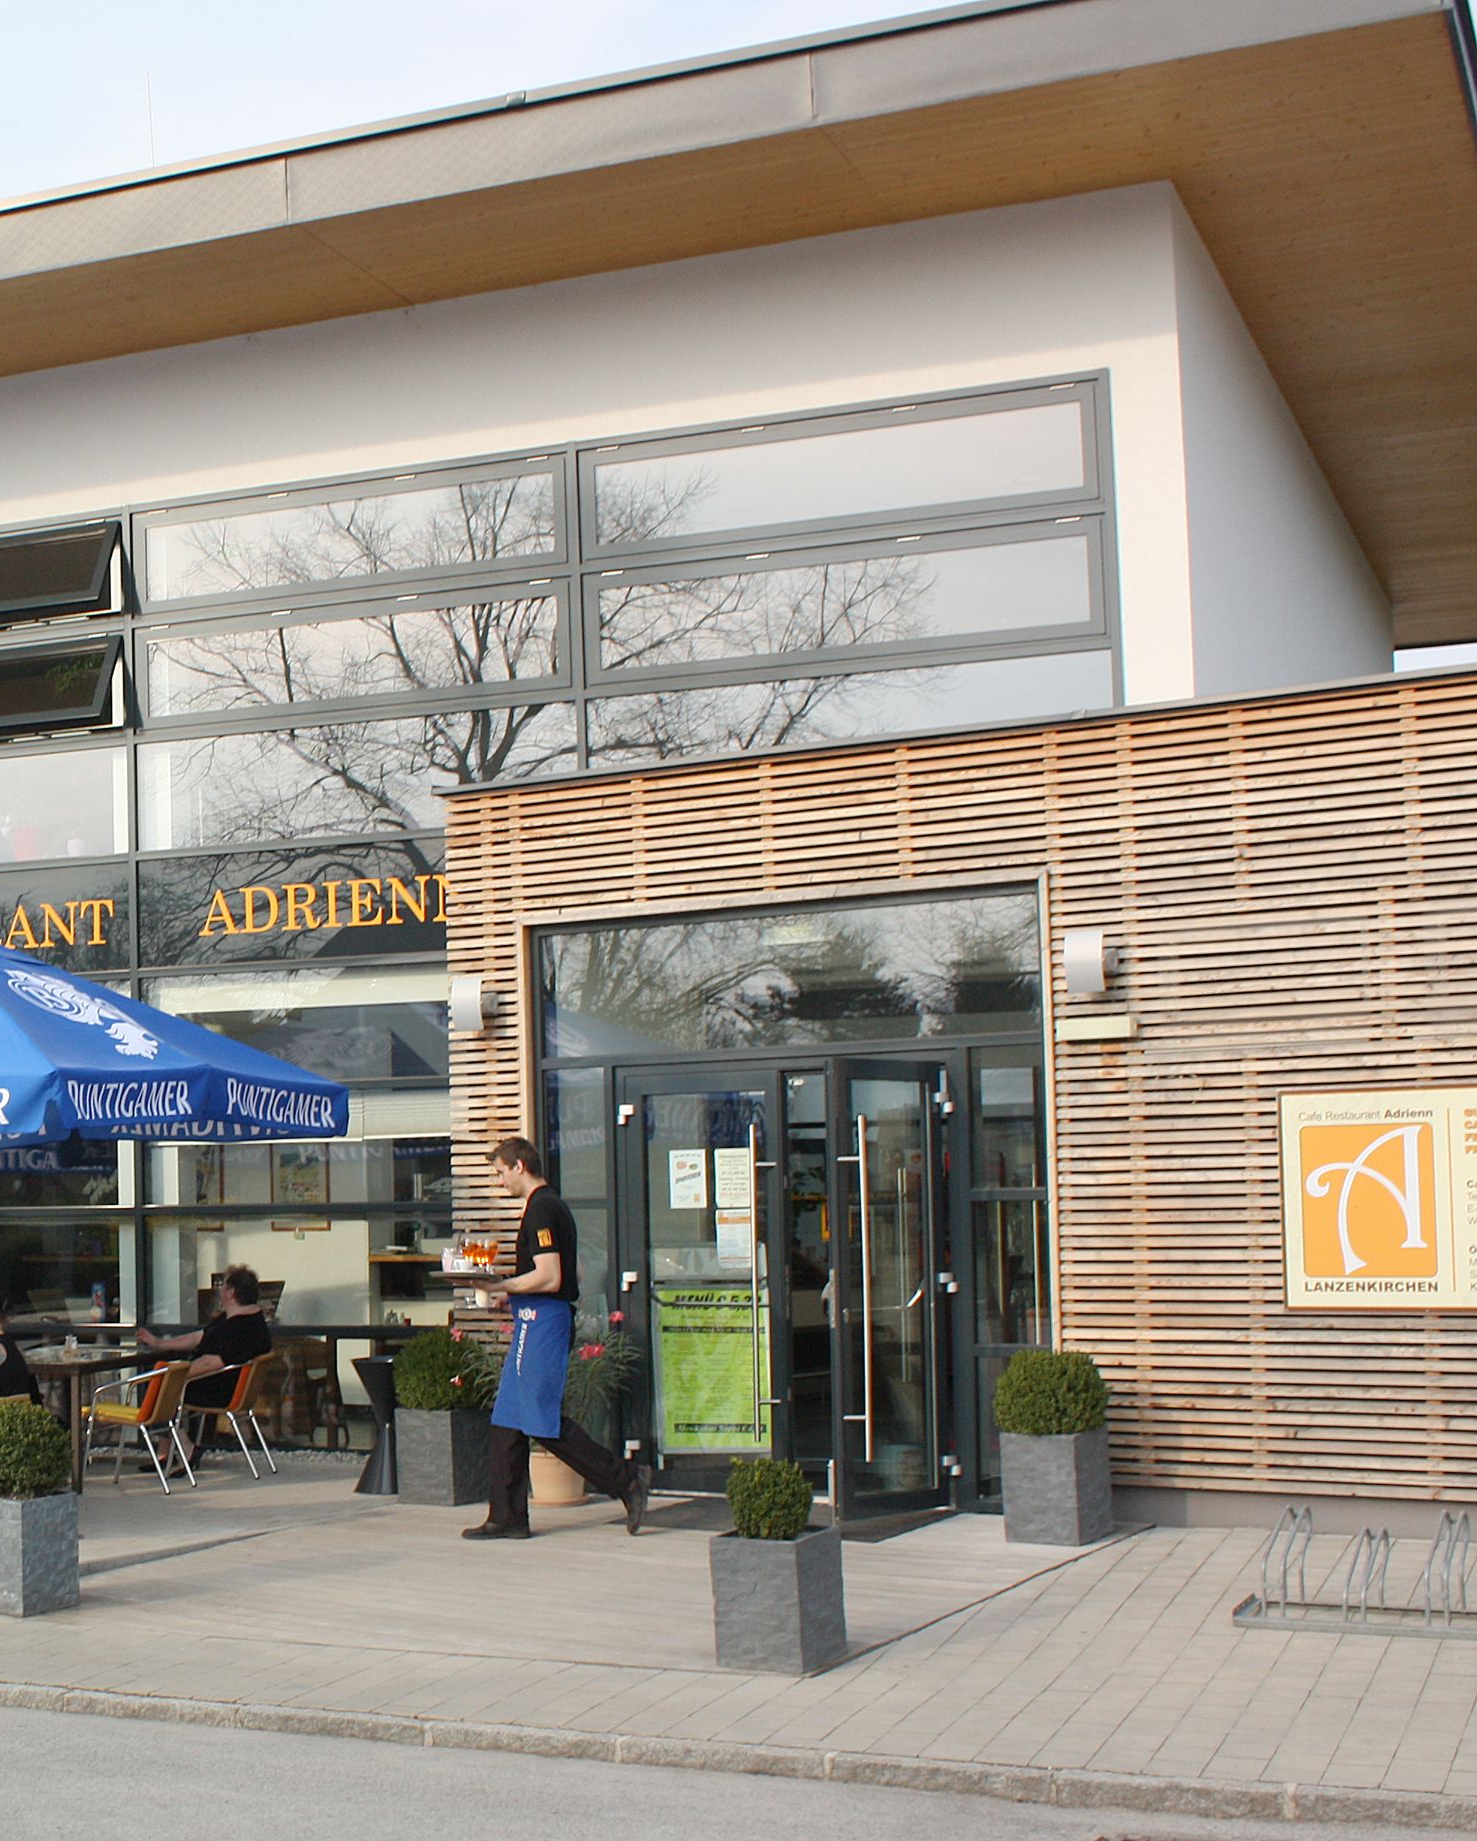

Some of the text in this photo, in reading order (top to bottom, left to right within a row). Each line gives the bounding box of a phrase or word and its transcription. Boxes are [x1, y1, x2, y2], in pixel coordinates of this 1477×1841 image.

[226, 1077, 336, 1129] PUNTIGAMER
[1298, 1108, 1434, 1122] Cafe Restaurant Adrienn
[1304, 1280, 1439, 1293] LANZENKIRCHEN
